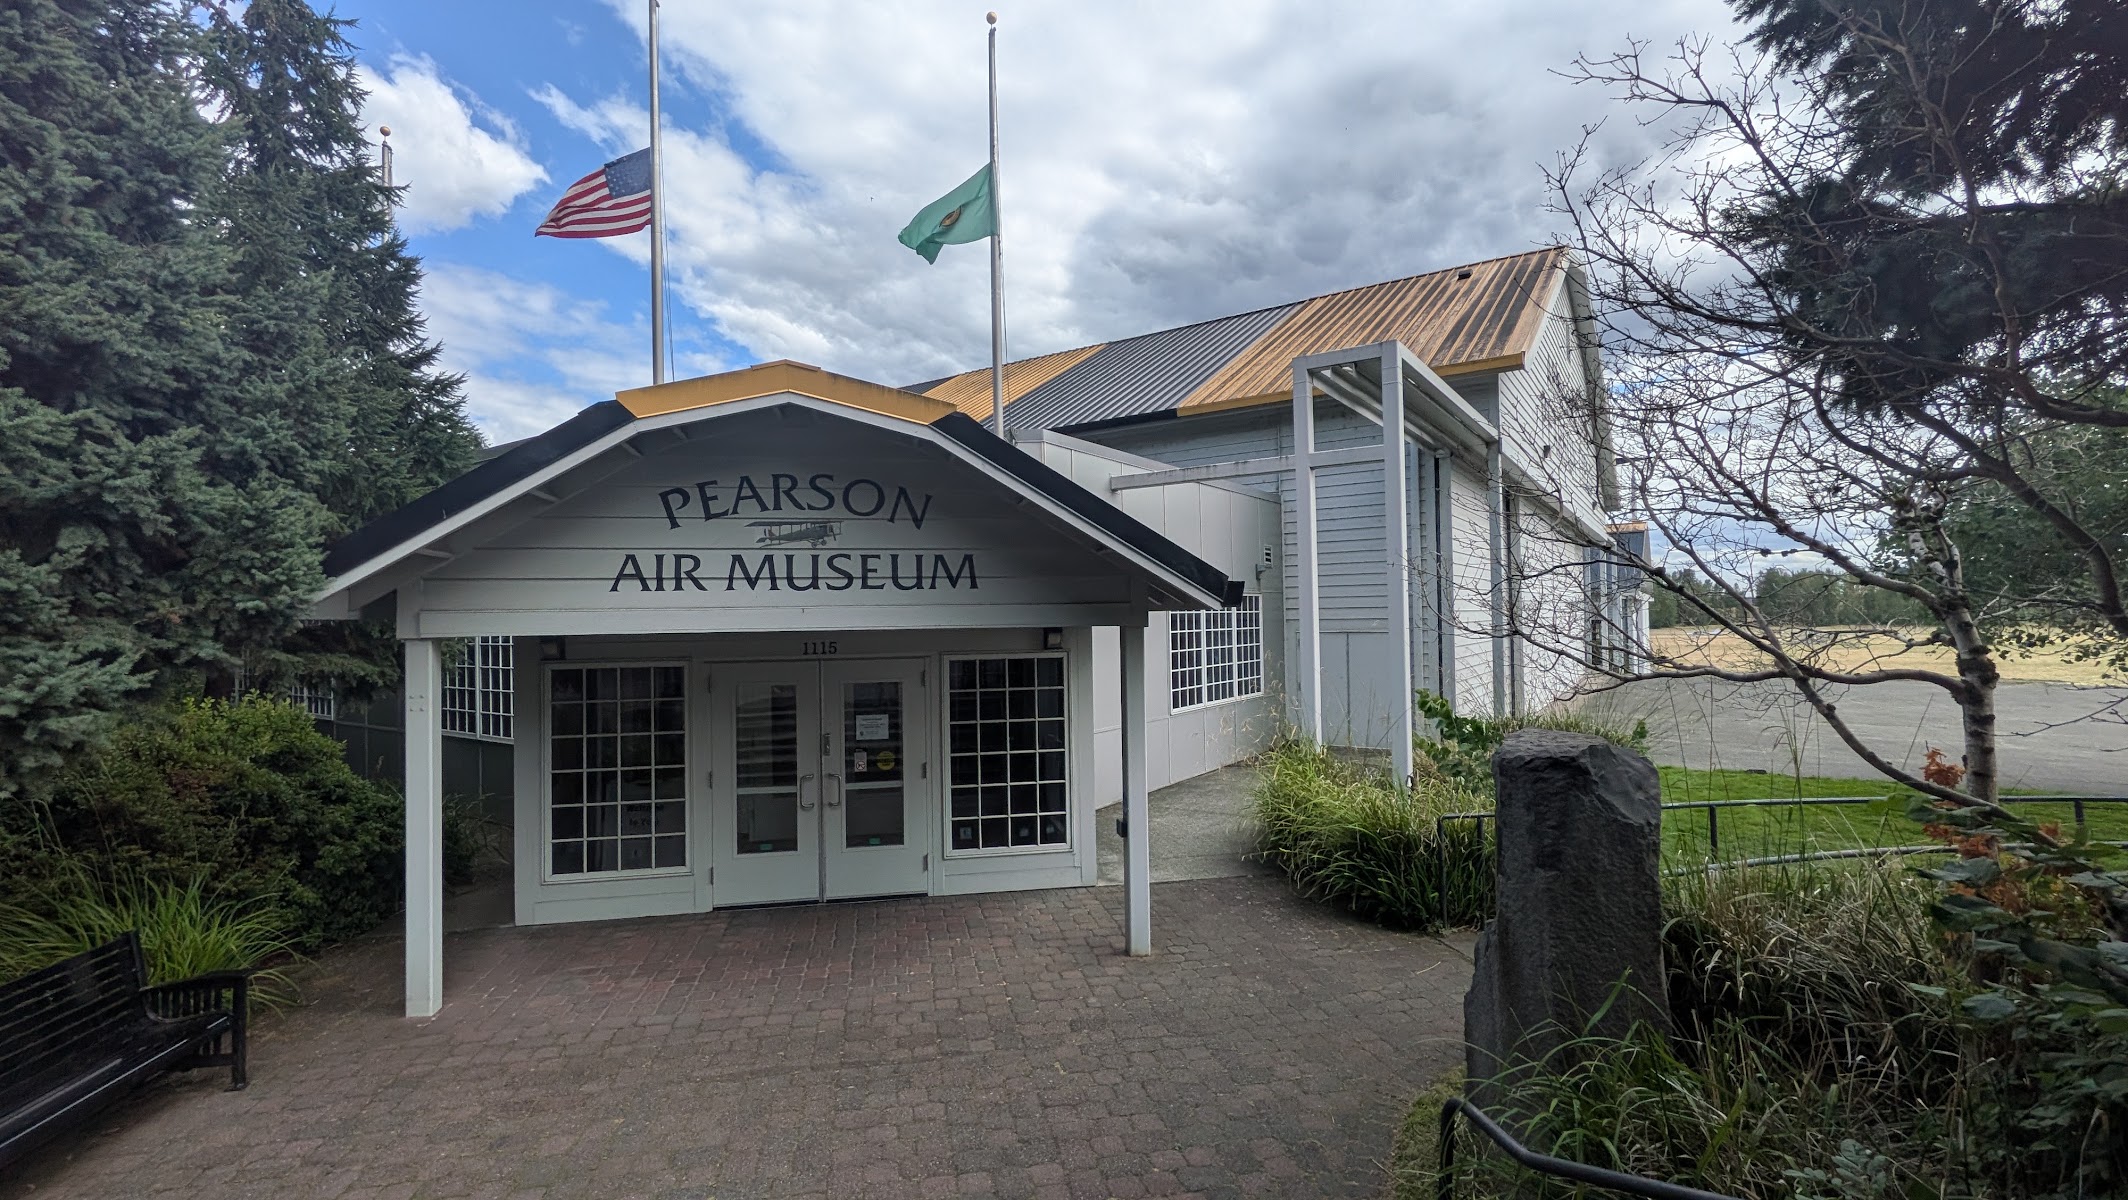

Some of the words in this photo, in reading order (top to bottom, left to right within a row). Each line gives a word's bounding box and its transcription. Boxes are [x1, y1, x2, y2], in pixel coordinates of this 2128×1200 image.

[658, 473, 933, 530] PEARSON
[609, 553, 708, 592] AIR
[724, 553, 979, 592] MUSEUM
[802, 641, 838, 656] 1115
